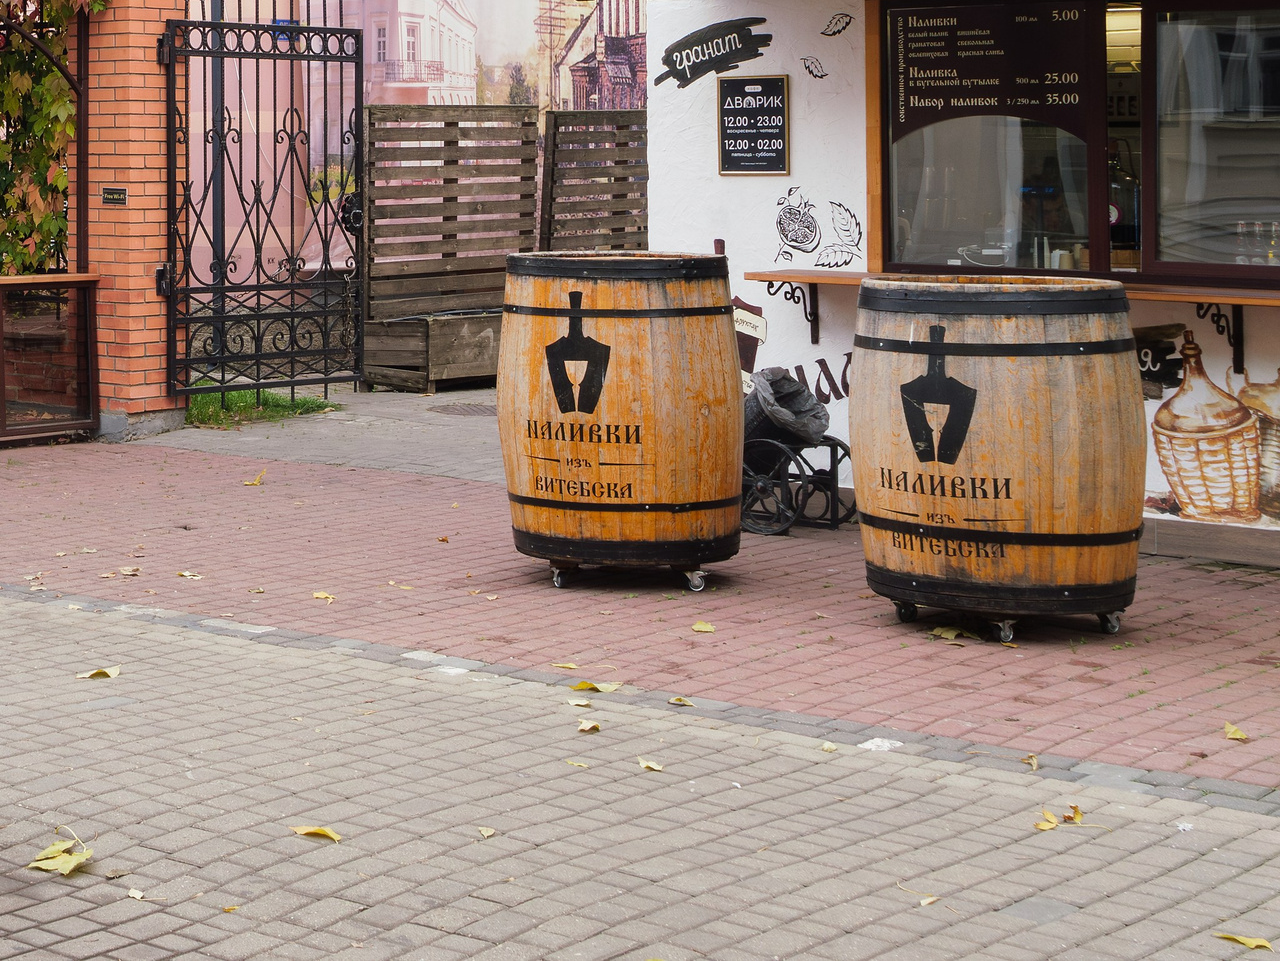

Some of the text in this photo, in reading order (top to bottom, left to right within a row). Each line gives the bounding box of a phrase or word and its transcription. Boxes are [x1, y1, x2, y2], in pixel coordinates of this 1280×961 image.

[1052, 9, 1079, 21] 5.00
[908, 41, 945, 49] гранатовая
[672, 33, 742, 78] гранат
[957, 50, 984, 58] красная
[909, 67, 958, 78] Наливка
[916, 78, 960, 89] бугельной
[962, 78, 1000, 89] бутылке
[1044, 72, 1079, 84] 25.00
[909, 95, 944, 110] Набор
[950, 97, 998, 106] наливок
[1046, 93, 1079, 105] 35.00
[723, 116, 783, 127] 12.00 23.00
[724, 139, 783, 150] 12.00 02.00
[526, 419, 642, 445] НАЛИВКИ
[535, 474, 633, 499] ВИТЕБСКА
[880, 466, 1013, 500] НАЛИВКИ
[892, 531, 1006, 558] ВИТЕБСКА
